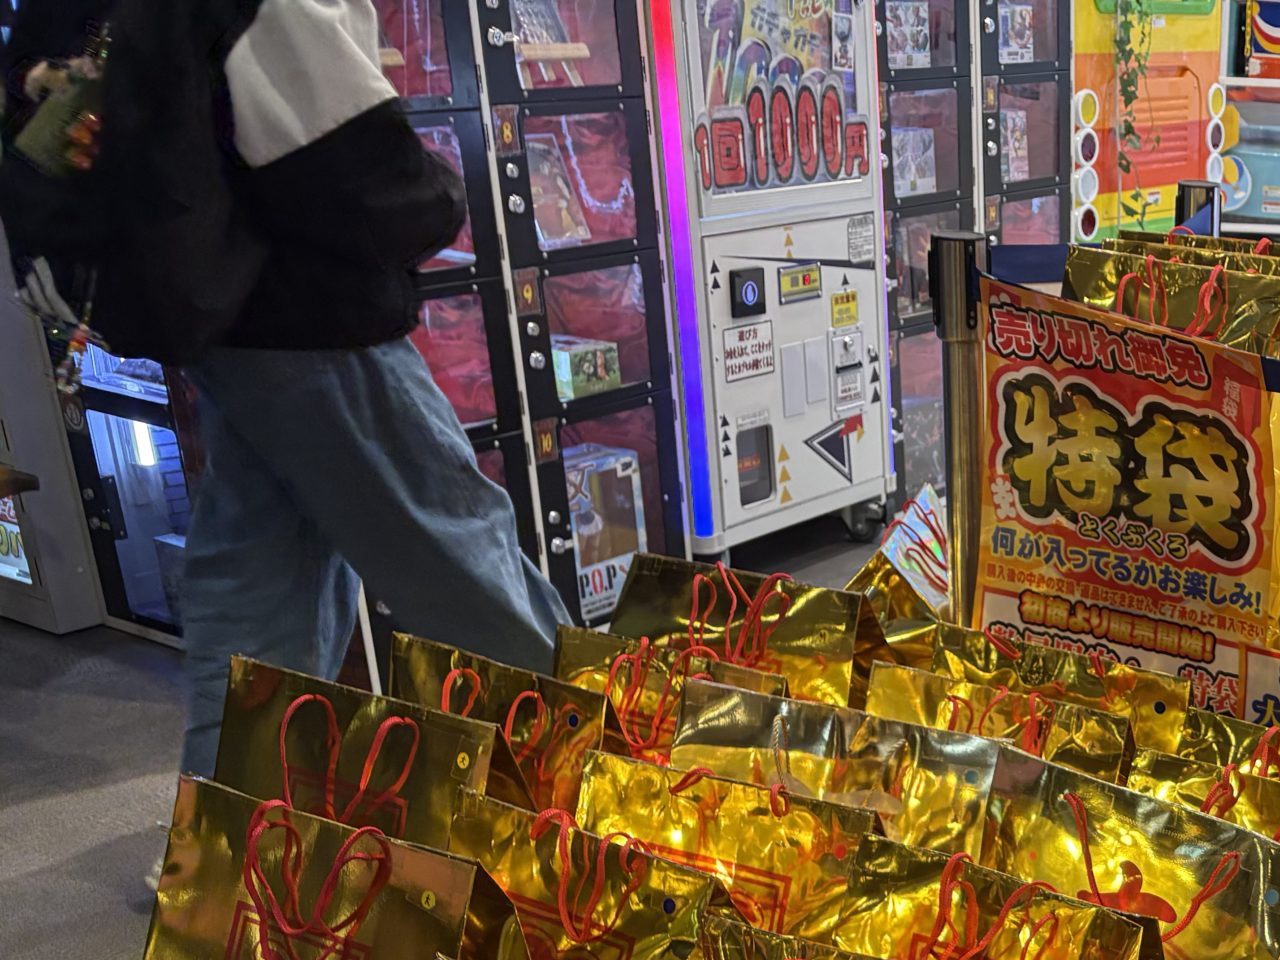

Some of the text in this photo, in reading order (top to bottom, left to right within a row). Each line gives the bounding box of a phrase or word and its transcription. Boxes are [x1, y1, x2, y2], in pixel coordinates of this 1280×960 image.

[502, 122, 513, 144] 8
[695, 84, 870, 190] 1回1000円
[523, 284, 532, 303] 9
[991, 305, 1211, 389] 売り切れ御免
[540, 434, 552, 452] 10
[1013, 385, 1241, 551] 特袋
[1078, 513, 1190, 559] とくぶくろ
